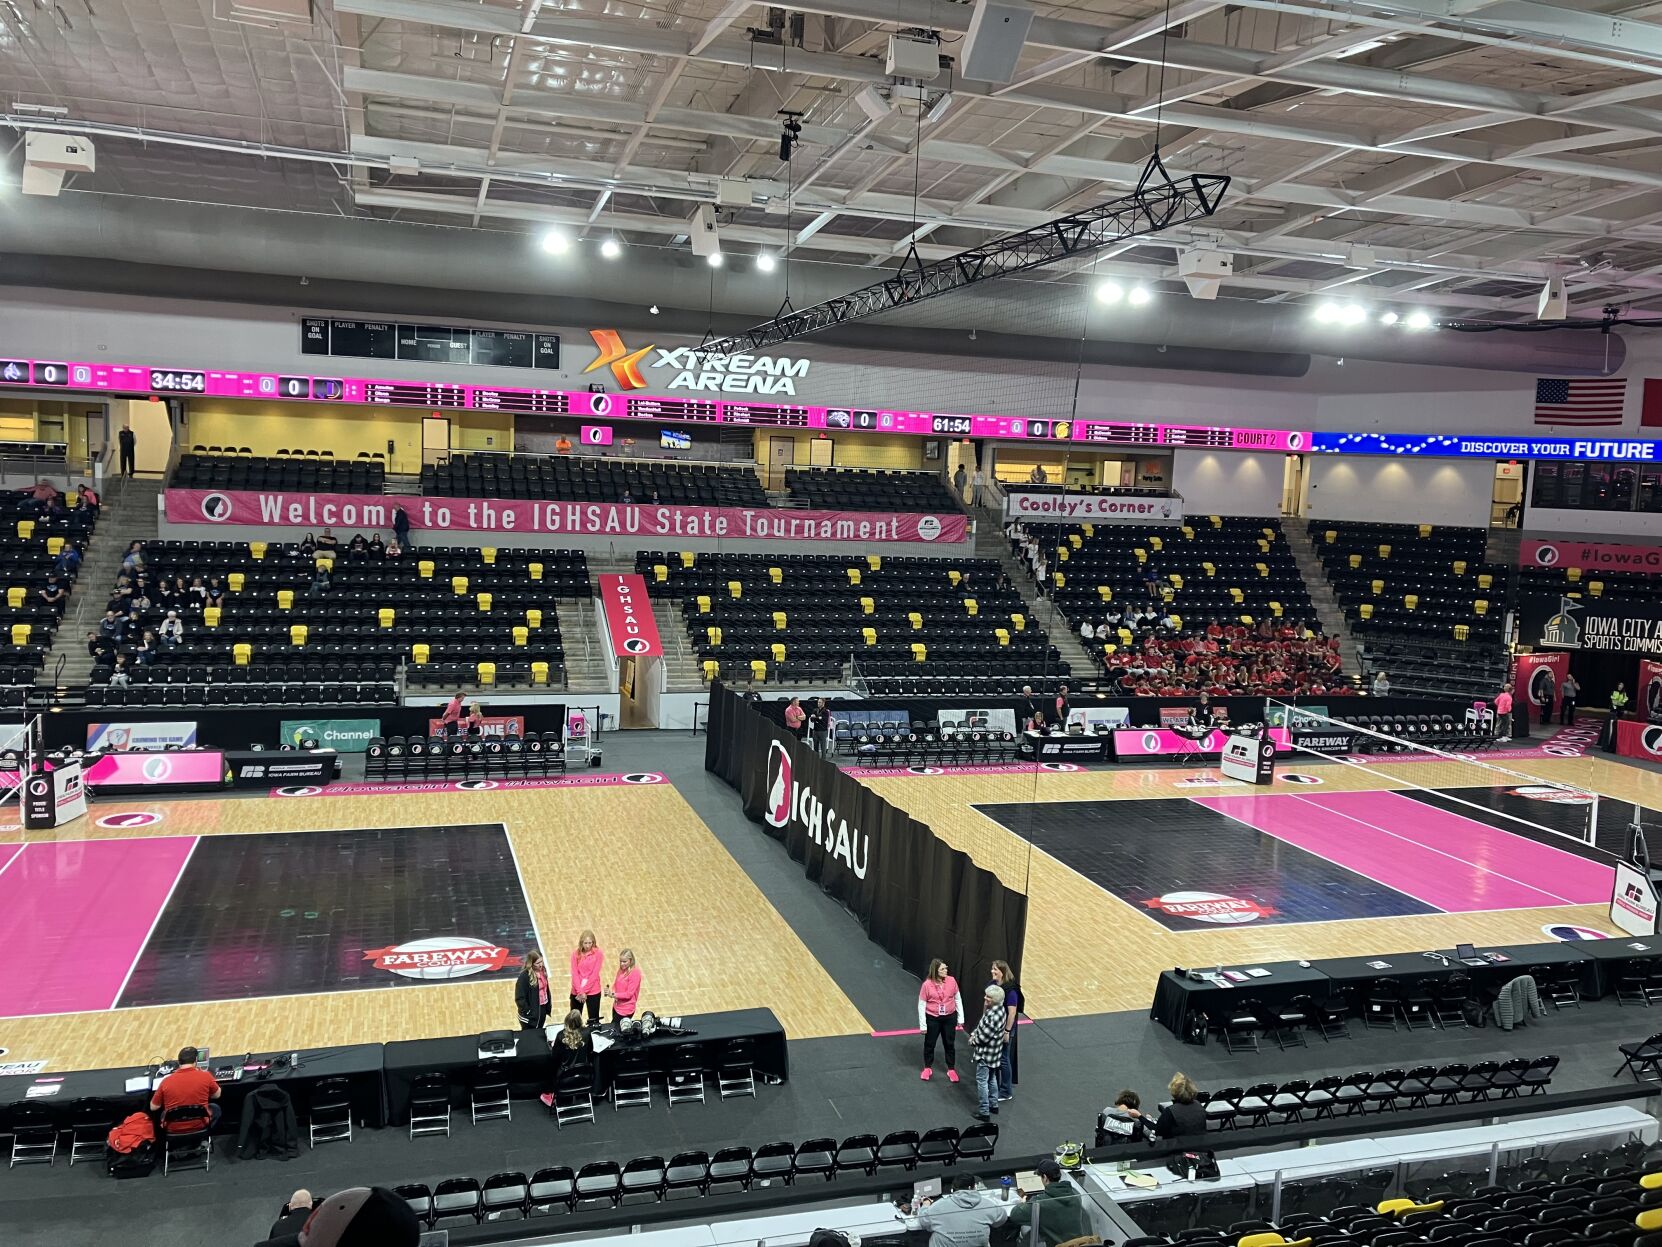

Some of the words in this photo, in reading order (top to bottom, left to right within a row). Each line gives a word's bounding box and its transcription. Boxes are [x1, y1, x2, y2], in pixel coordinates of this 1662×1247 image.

[364, 323, 388, 331] PENALTY
[400, 338, 417, 346] HOME
[651, 347, 811, 378] XTREAM
[44, 366, 56, 382] 0
[151, 373, 204, 391] 34:54
[288, 380, 299, 395] 0
[667, 371, 796, 396] ARENA
[860, 413, 869, 426] 0
[933, 418, 970, 432] 61:54
[1034, 423, 1042, 436] 0
[1237, 432, 1268, 445] COURT
[1271, 434, 1276, 446] 2
[1461, 441, 1529, 454] DISCOVER
[1532, 443, 1571, 454] YOUR
[1574, 442, 1654, 459] FUTURE
[1019, 496, 1093, 516] Cooley's
[1098, 498, 1154, 514] Corner
[259, 495, 402, 526] Welcom
[423, 501, 451, 526] to
[468, 502, 515, 529] the
[533, 503, 640, 532] IGHSAU
[656, 508, 728, 536] State
[743, 511, 898, 539] Tournament
[617, 575, 639, 634] IGHSAU
[1585, 616, 1619, 636] IOWA
[1623, 619, 1652, 638] CITY
[1584, 635, 1622, 649] SPORTS
[1529, 655, 1560, 663] #IowaGirl
[324, 730, 374, 740] Channel
[1297, 737, 1350, 747] FAREWAY
[1163, 901, 1252, 912] FAREWAY
[383, 949, 501, 964] FAREWAY
